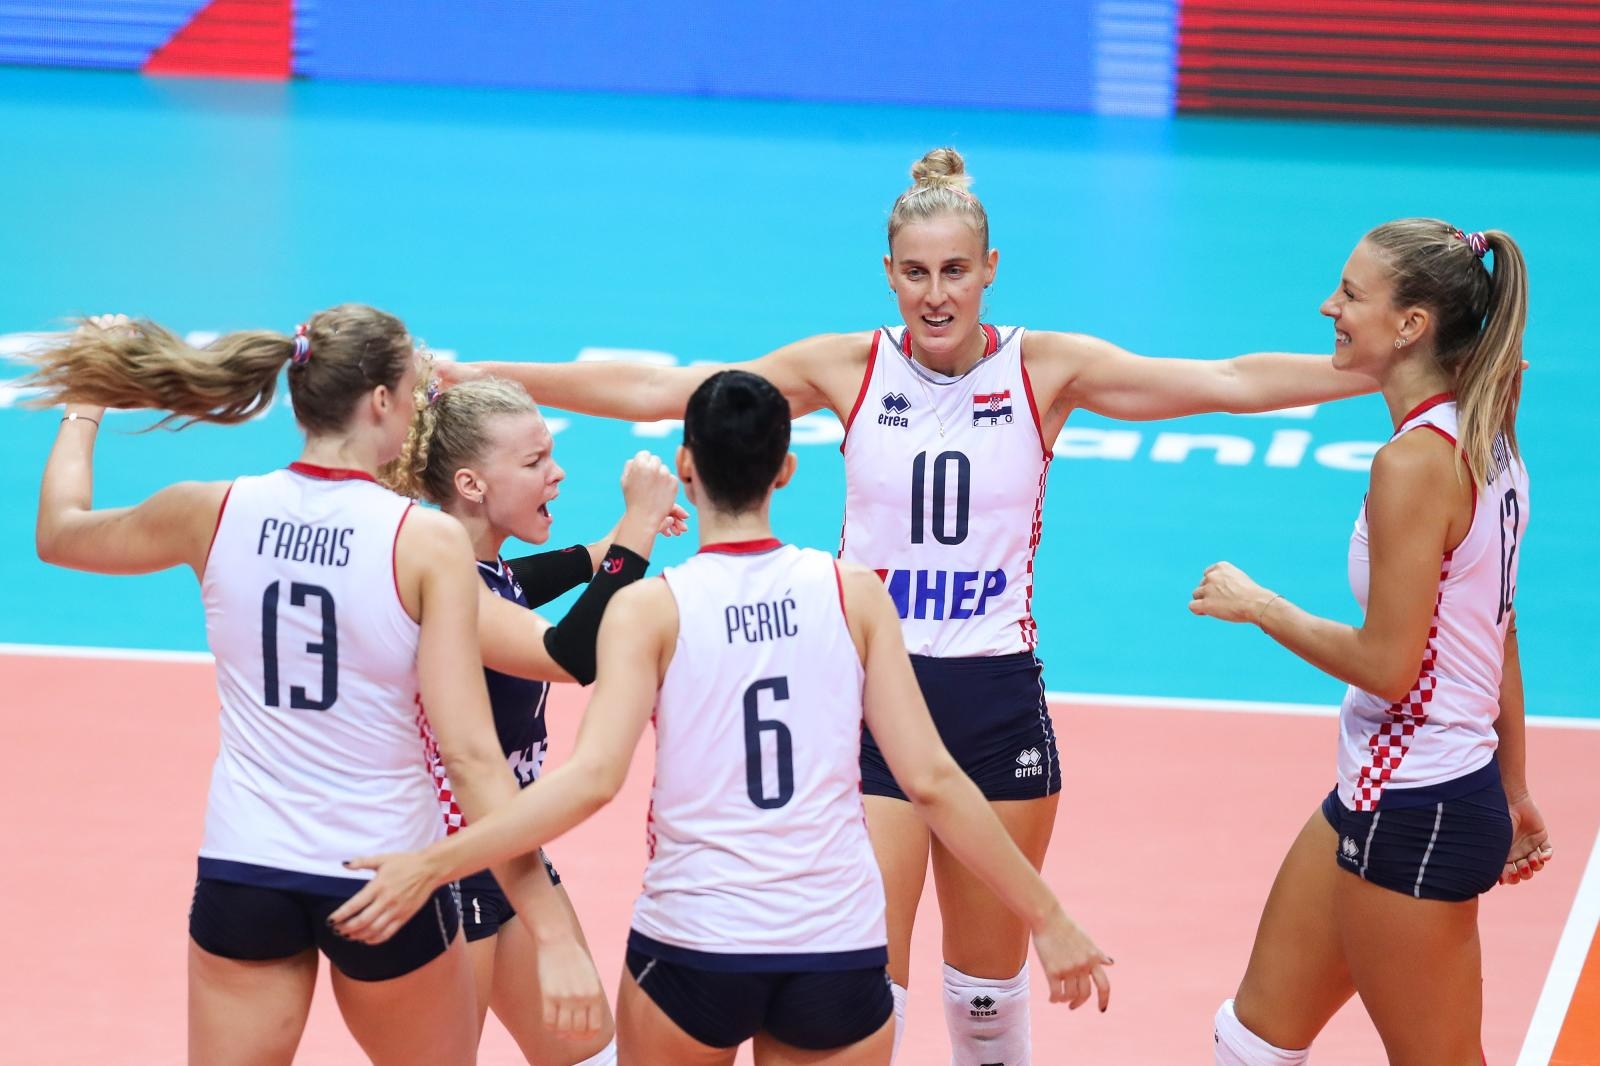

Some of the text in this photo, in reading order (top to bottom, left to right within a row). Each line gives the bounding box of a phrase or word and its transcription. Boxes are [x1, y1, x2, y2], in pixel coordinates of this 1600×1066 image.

[878, 413, 908, 428] errea
[973, 414, 1013, 427] CRO
[911, 451, 970, 545] 10
[257, 517, 354, 567] FABRIS
[725, 588, 798, 644] PERIĆ
[914, 568, 1007, 620] HEP
[262, 580, 338, 711] 13
[743, 676, 794, 809] 6
[1014, 765, 1043, 778] errea
